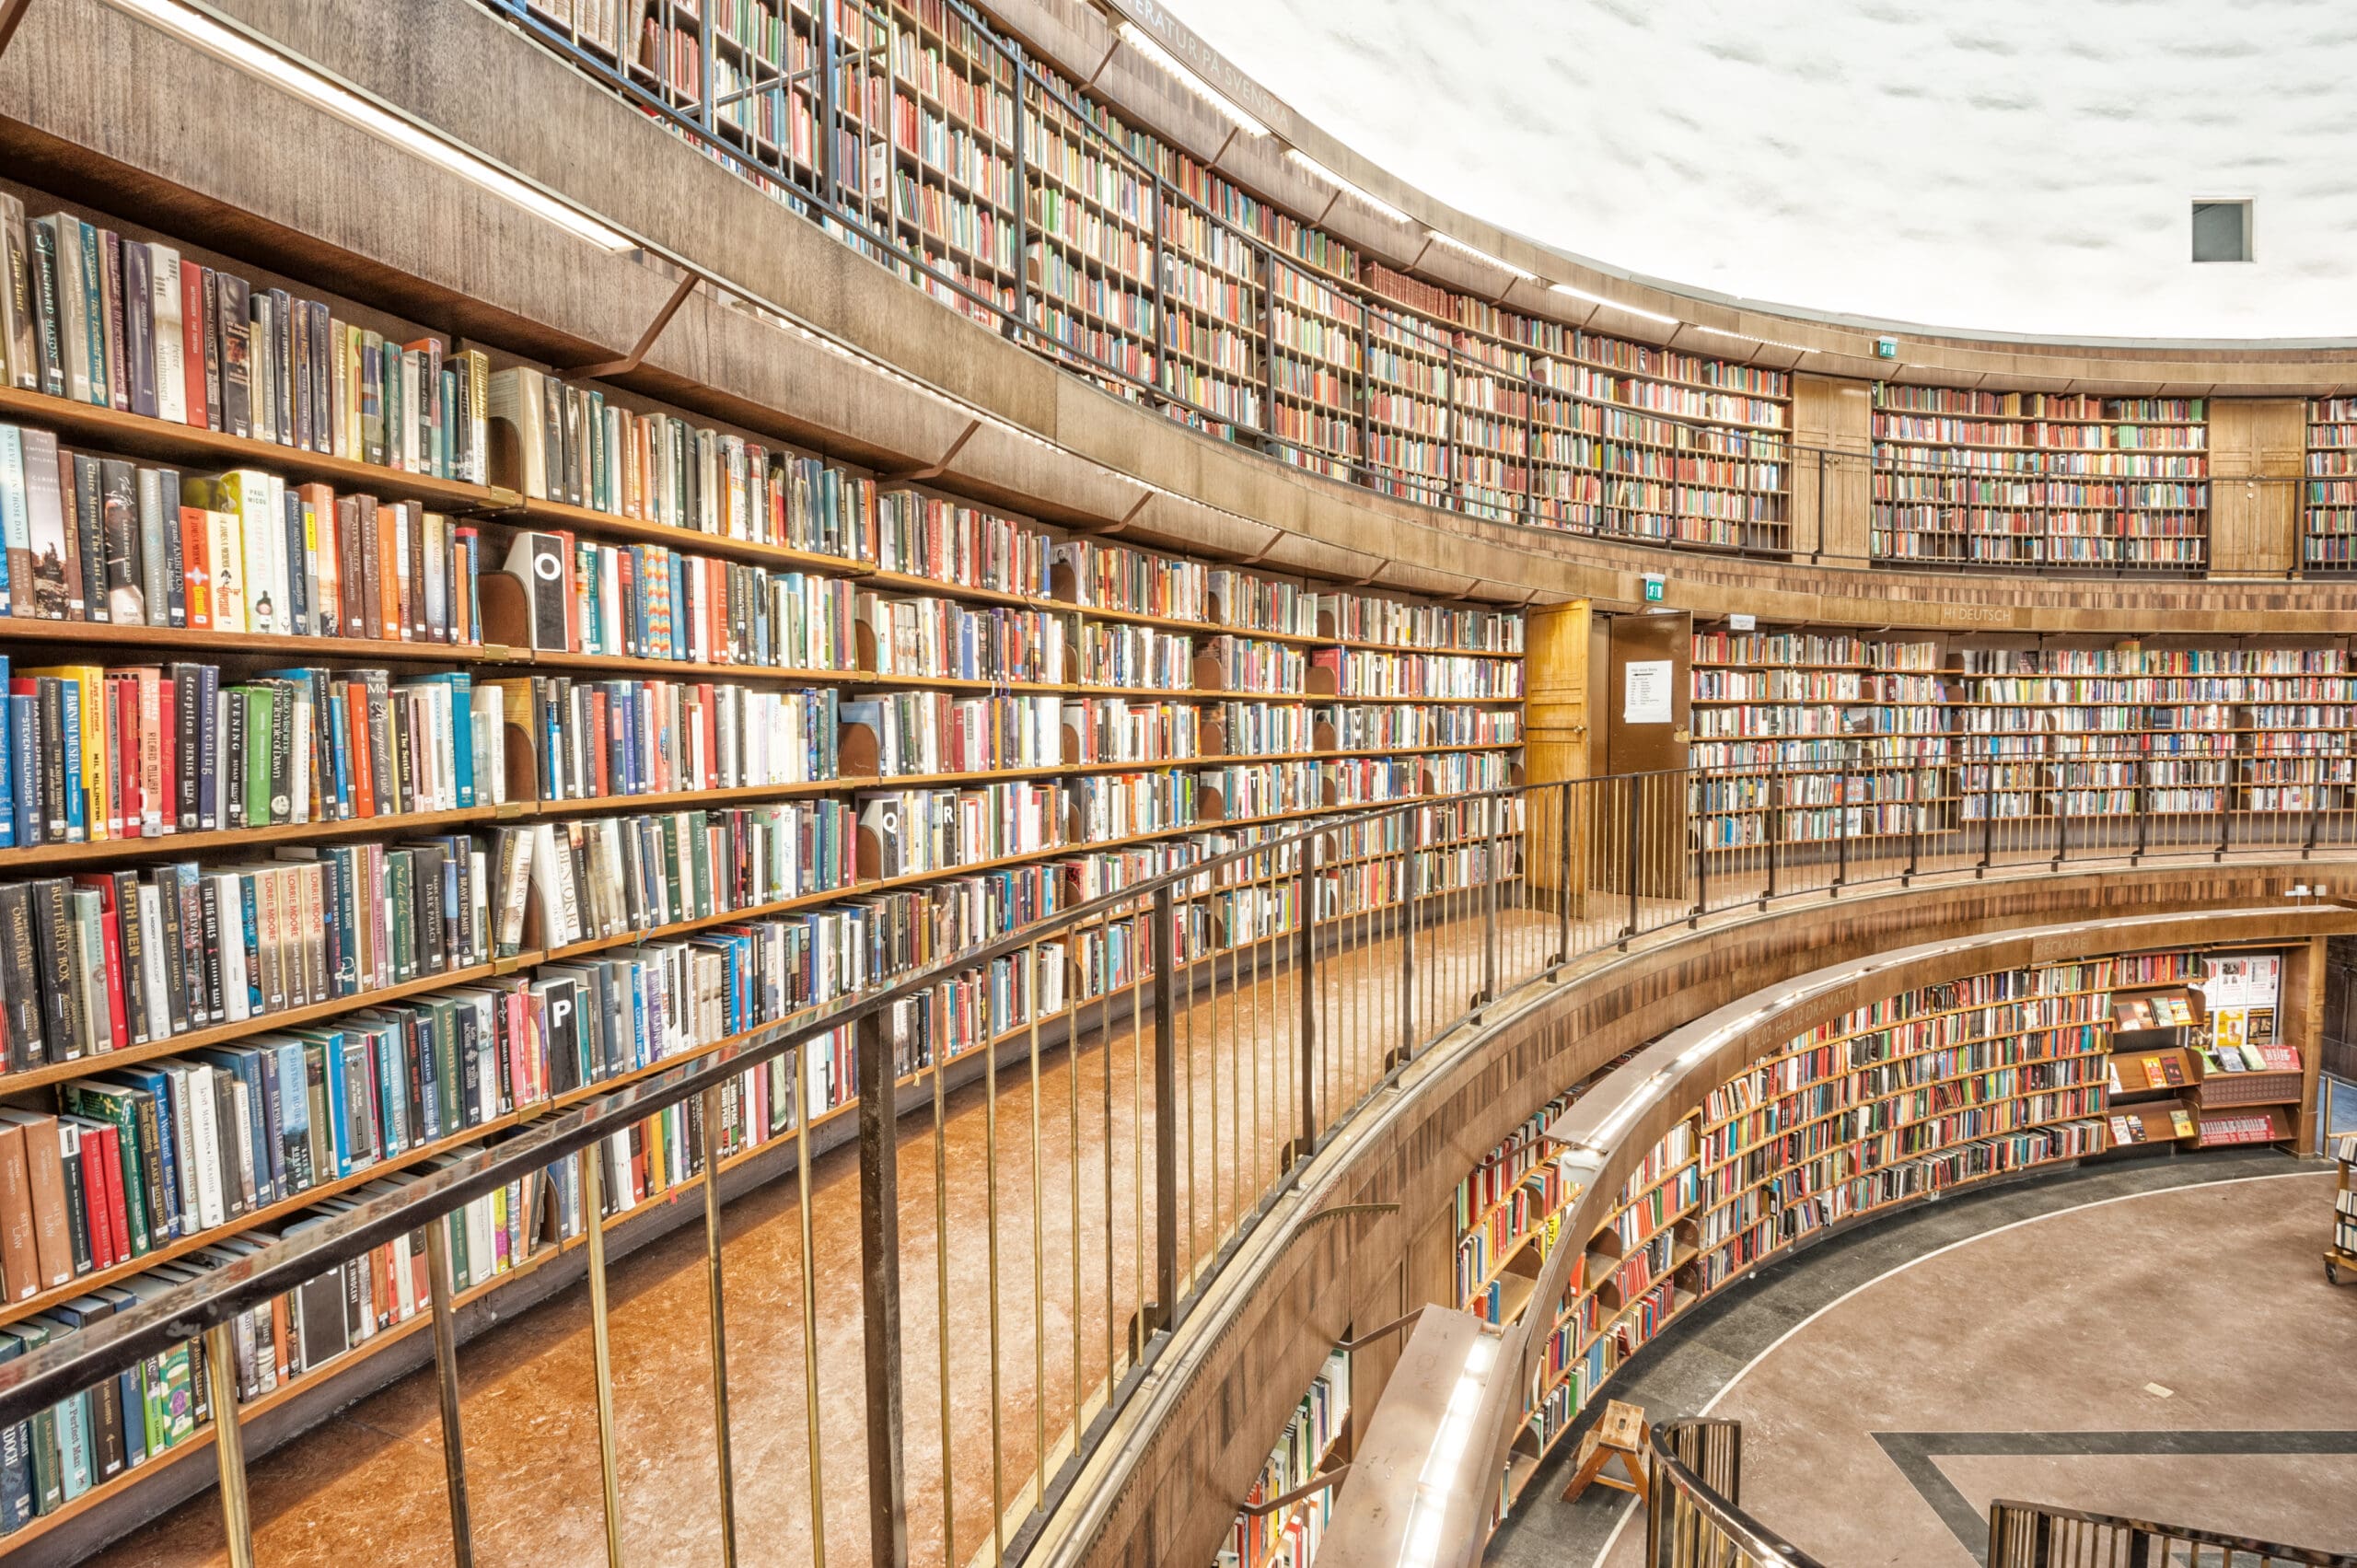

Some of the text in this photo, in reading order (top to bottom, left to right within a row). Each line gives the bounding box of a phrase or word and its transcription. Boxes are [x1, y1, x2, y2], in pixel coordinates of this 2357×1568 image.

[1224, 65, 1290, 128] SVENSKA
[12, 250, 25, 312] Piano Tuner
[42, 261, 58, 359] RICHARD MASON
[157, 343, 169, 401] Matthiessen
[172, 343, 181, 368] Peter
[87, 463, 104, 600] Claire Messud The Last Life
[122, 519, 130, 540] SARAH
[21, 557, 29, 589] ROLAND
[124, 562, 133, 583] MIANO
[168, 519, 184, 594] grand AMBITION
[534, 552, 563, 580] O
[1958, 608, 2012, 621] DEUTSCH
[319, 675, 328, 691] SUCH
[367, 682, 388, 694] MO
[201, 669, 215, 776] SUSAN MINOT evening
[282, 687, 293, 756] Yukio Mishima
[319, 696, 329, 713] LONG
[1354, 714, 1362, 726] V
[50, 705, 58, 742] MILLHAUSER
[66, 694, 81, 774] BARNUM MUSEUM
[184, 676, 196, 806] deception DENISE MINA
[270, 686, 284, 779] The Temple of Dawn
[320, 712, 330, 737] JOURNEY
[21, 716, 34, 807] STEVEN MILLHAUSER
[33, 700, 44, 807] MARTIN DRESSLER
[146, 731, 158, 795] RICHARD MILWARD
[231, 693, 241, 804] EVENING SUSAN MINOT
[401, 730, 411, 782] The Settlers
[93, 772, 101, 821] MILLINGTON
[1250, 776, 1259, 789] T
[884, 812, 898, 834] Q
[945, 806, 955, 823] R
[1504, 804, 1508, 814] Y
[374, 850, 382, 874] BRIAN
[123, 879, 137, 920] FIFTH
[203, 887, 214, 901] THE
[342, 854, 353, 930] LIES OF SILENCE BRIAN MOORE
[375, 873, 383, 900] MOORE
[459, 876, 468, 902] BRAVE
[512, 855, 532, 924] THIS ROCK
[558, 848, 579, 930] BEN OKRI
[205, 901, 215, 917] BIG
[206, 916, 217, 939] GIRLS
[425, 883, 437, 945] DARK PALACE
[460, 901, 470, 936] ENEMIES
[12, 906, 27, 971] OMBU TREE
[51, 885, 71, 983] BUTTERFLY BOX
[126, 923, 141, 958] MEN
[165, 881, 181, 992] RICK MOODY PURPLE AMERICA
[245, 886, 259, 988] LISA MOORE FEBRUARY
[376, 913, 385, 953] STATEMENT
[2036, 938, 2087, 958] DECKARE
[210, 958, 218, 986] SUSANNA
[552, 999, 572, 1028] P
[1805, 986, 1857, 1021] DRAMATIK
[422, 1028, 431, 1052] NIGHT
[463, 1021, 473, 1050] MOSSE
[470, 1026, 479, 1041] Kate
[379, 1036, 390, 1086] WALTER MOSLEY
[423, 1052, 434, 1082] WAKING
[156, 1084, 164, 1097] The
[198, 1087, 207, 1107] TONI
[289, 1056, 303, 1124] DISTANT HOURS
[389, 1060, 401, 1110] NICHOLAS
[425, 1085, 435, 1109] SARAH
[157, 1098, 168, 1118] Last
[721, 1086, 730, 1130] DAVID PEACE
[730, 1083, 739, 1127] DAVID PEACE
[160, 1118, 173, 1160] Weekend
[201, 1109, 214, 1151] MORRISON
[149, 1156, 159, 1184] BLAKE
[164, 1165, 175, 1186] Blake
[292, 1144, 303, 1179] MORTON
[90, 1139, 110, 1261] Toni Morrison The Bluest Eye
[152, 1185, 165, 1226] MORRISON
[12, 1211, 30, 1249] KIT'S LAW
[43, 1200, 64, 1238] KIT'S LAW
[349, 1268, 359, 1305] INNOCENT
[261, 1321, 271, 1344] THEN
[68, 1408, 82, 1469] Perfect Man
